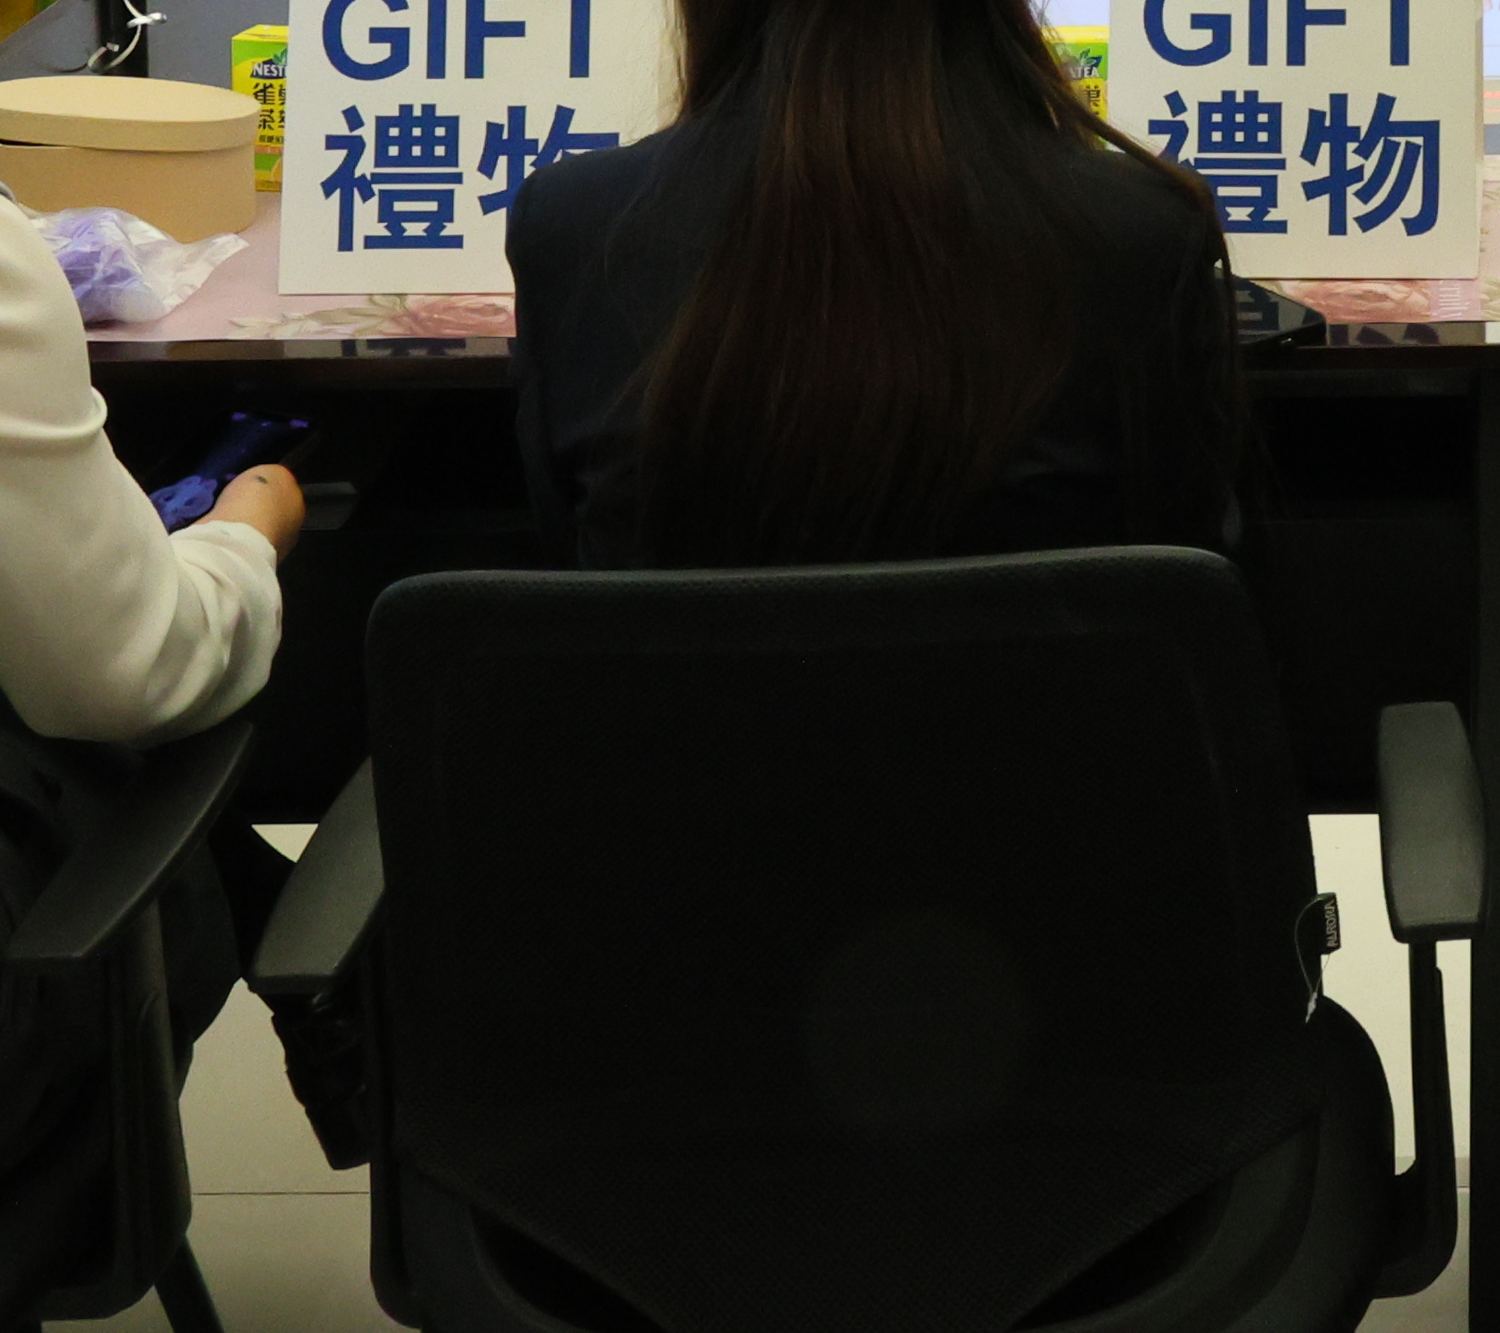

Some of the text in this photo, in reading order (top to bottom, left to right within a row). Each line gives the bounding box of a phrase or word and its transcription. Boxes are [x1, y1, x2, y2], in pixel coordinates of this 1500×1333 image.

[252, 61, 286, 78] NEST
[1070, 66, 1101, 79] TEA
[1147, 89, 1443, 237] 禮物
